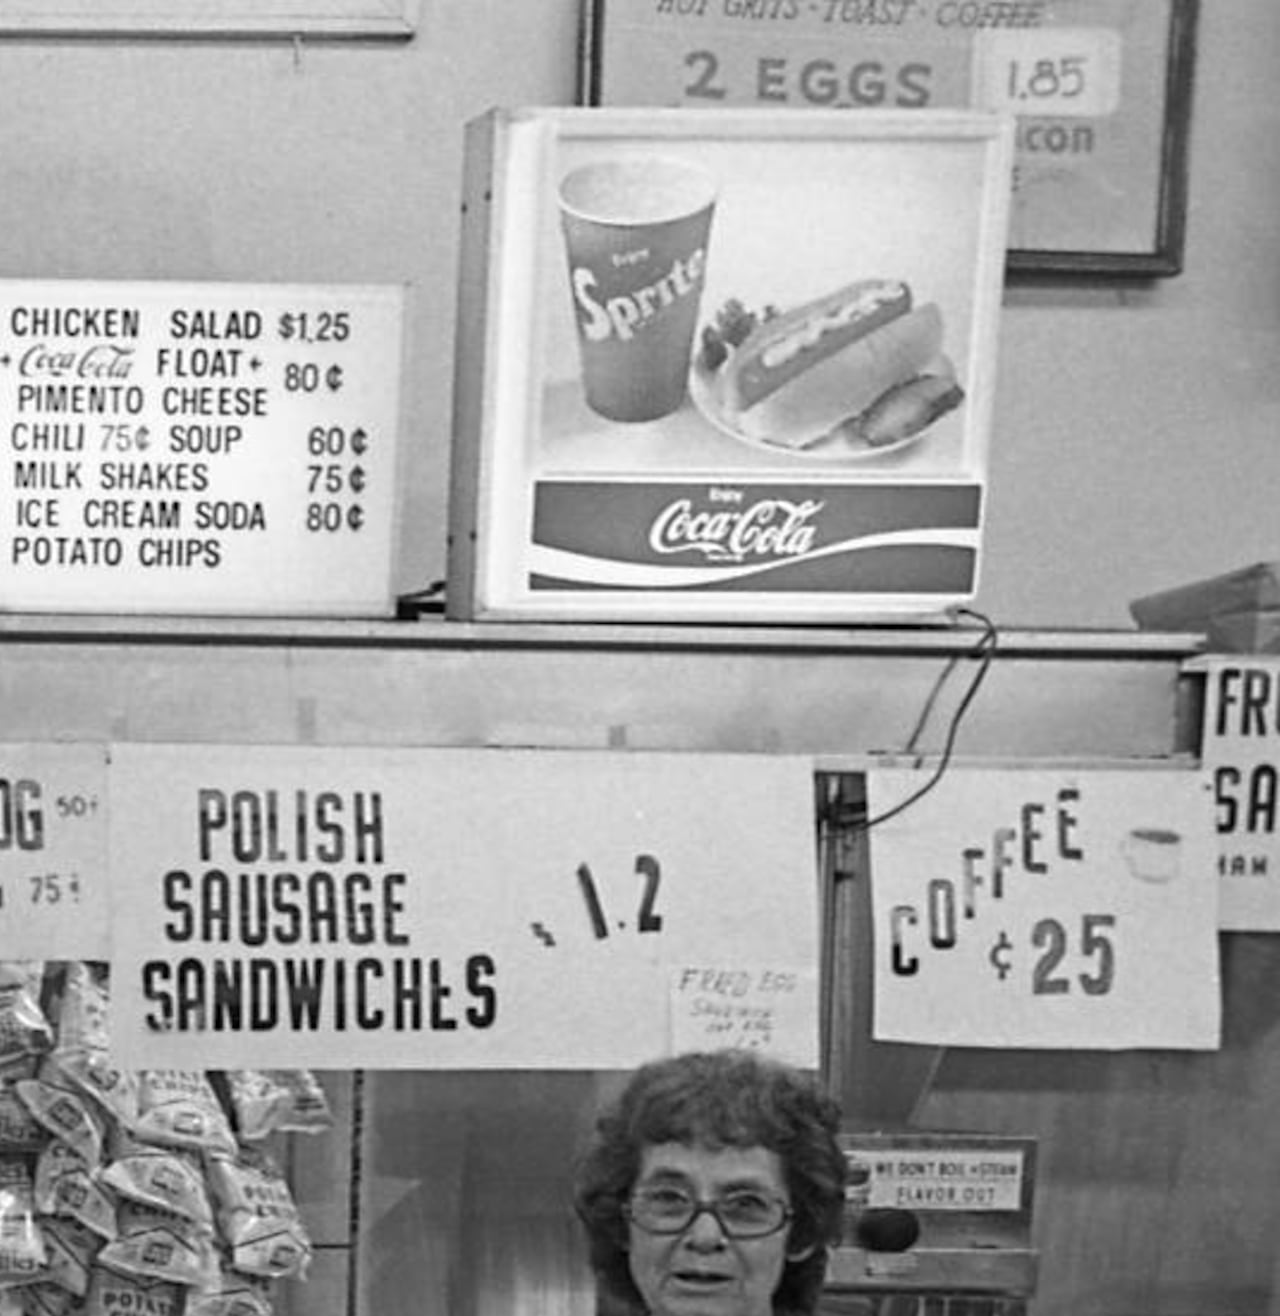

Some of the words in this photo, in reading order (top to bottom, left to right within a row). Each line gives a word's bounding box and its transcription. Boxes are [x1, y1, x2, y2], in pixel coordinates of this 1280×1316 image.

[684, 50, 726, 100] 2
[756, 57, 932, 108] EGGS
[1008, 57, 1088, 101] 1.85
[573, 247, 704, 341] Sprite
[11, 307, 139, 338] CHICKEN
[171, 310, 262, 340] SALAD
[279, 313, 349, 343] $1.25
[158, 349, 243, 378] FLOAT
[19, 385, 143, 415] PIMENTO
[163, 387, 268, 416] CHEESE
[12, 423, 85, 451] CHILI
[100, 424, 150, 451] 75¢
[170, 425, 242, 453] SOUP
[14, 462, 82, 490] MILK
[100, 463, 209, 491] SHAKES
[17, 499, 59, 528] ICE
[84, 500, 180, 529] CREAM
[196, 502, 266, 531] SODA
[12, 537, 122, 567] POTATO
[139, 539, 221, 568] CHIPS
[1216, 668, 1280, 736] FR
[198, 789, 383, 863] POLISH
[890, 789, 1083, 977] COFFEE
[163, 871, 409, 946] SAUSAGE
